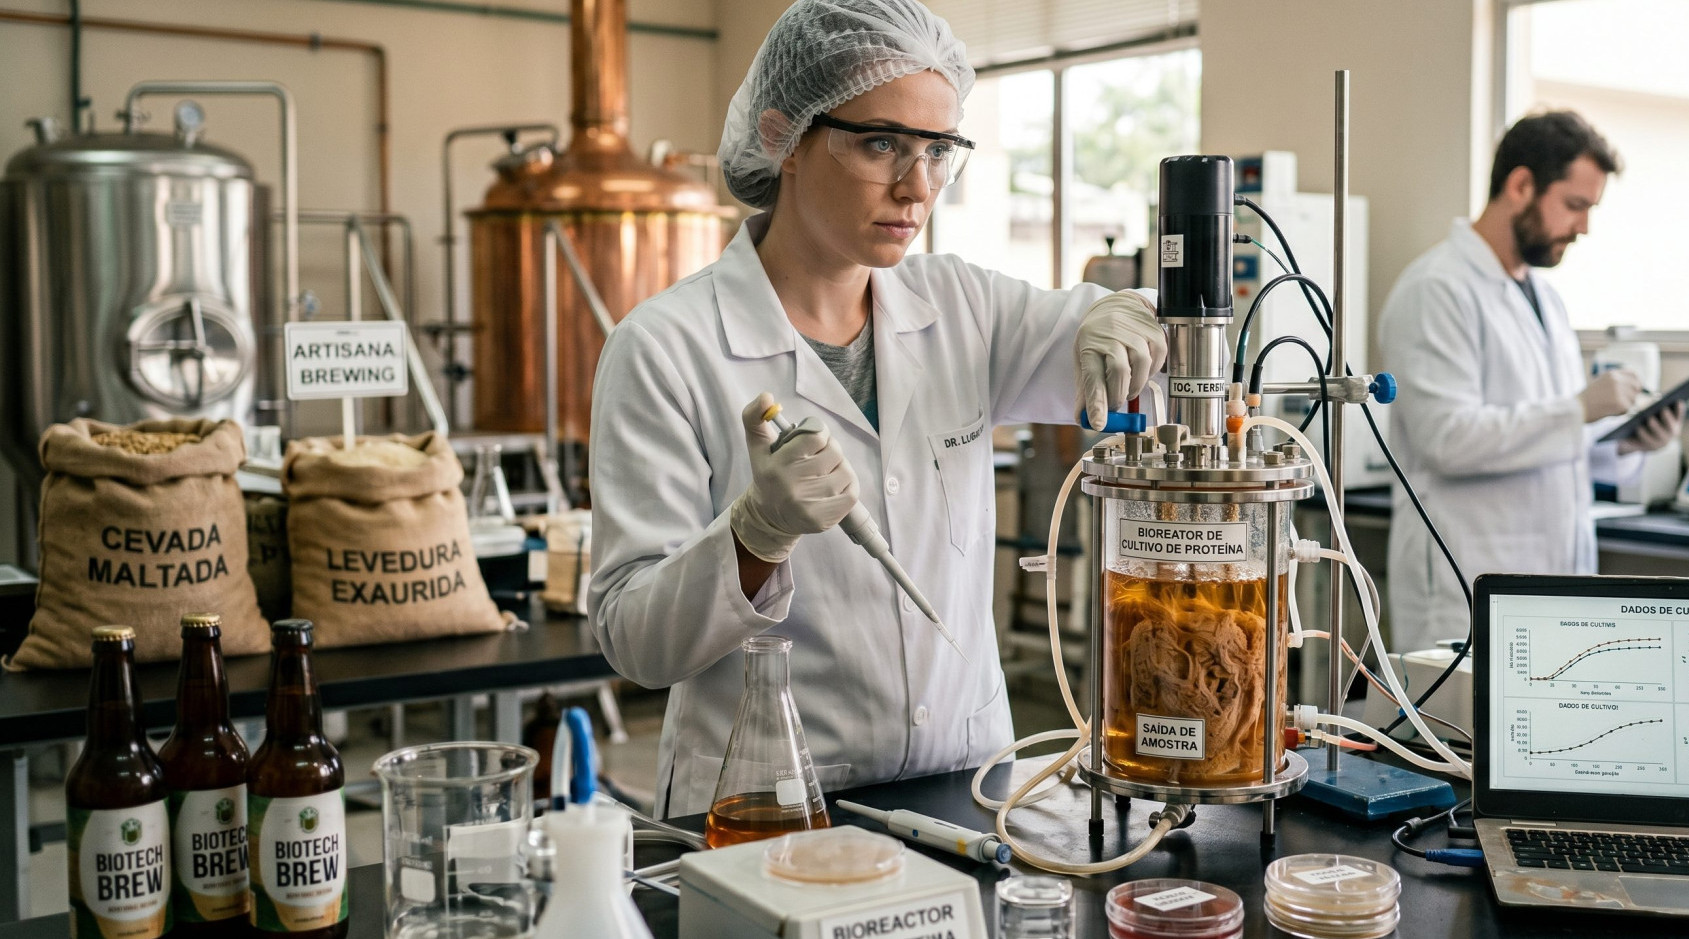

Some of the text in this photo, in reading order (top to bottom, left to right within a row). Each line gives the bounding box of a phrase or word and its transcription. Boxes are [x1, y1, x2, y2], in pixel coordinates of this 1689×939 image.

[301, 366, 396, 385] BREWING
[944, 437, 961, 448] DR.
[101, 523, 221, 554] CEVADA
[1121, 539, 1244, 555] CULTIVO DE PROTEÍNA
[1138, 527, 1223, 541] BIOREATOR DE
[326, 539, 462, 573] LEVEDURA
[88, 554, 228, 588] MALTADA
[331, 571, 467, 605] EXAURIDA
[1621, 605, 1657, 615] DADOS
[1659, 606, 1673, 615] DE
[1143, 722, 1196, 737] SAÍDA DE
[1141, 737, 1198, 751] AMOSTRA
[96, 844, 163, 872] BIOTECH
[275, 833, 339, 860] BIOTECH
[97, 865, 163, 901] BREW
[276, 854, 339, 888] BREW
[833, 904, 954, 939] BIOREACTOR
